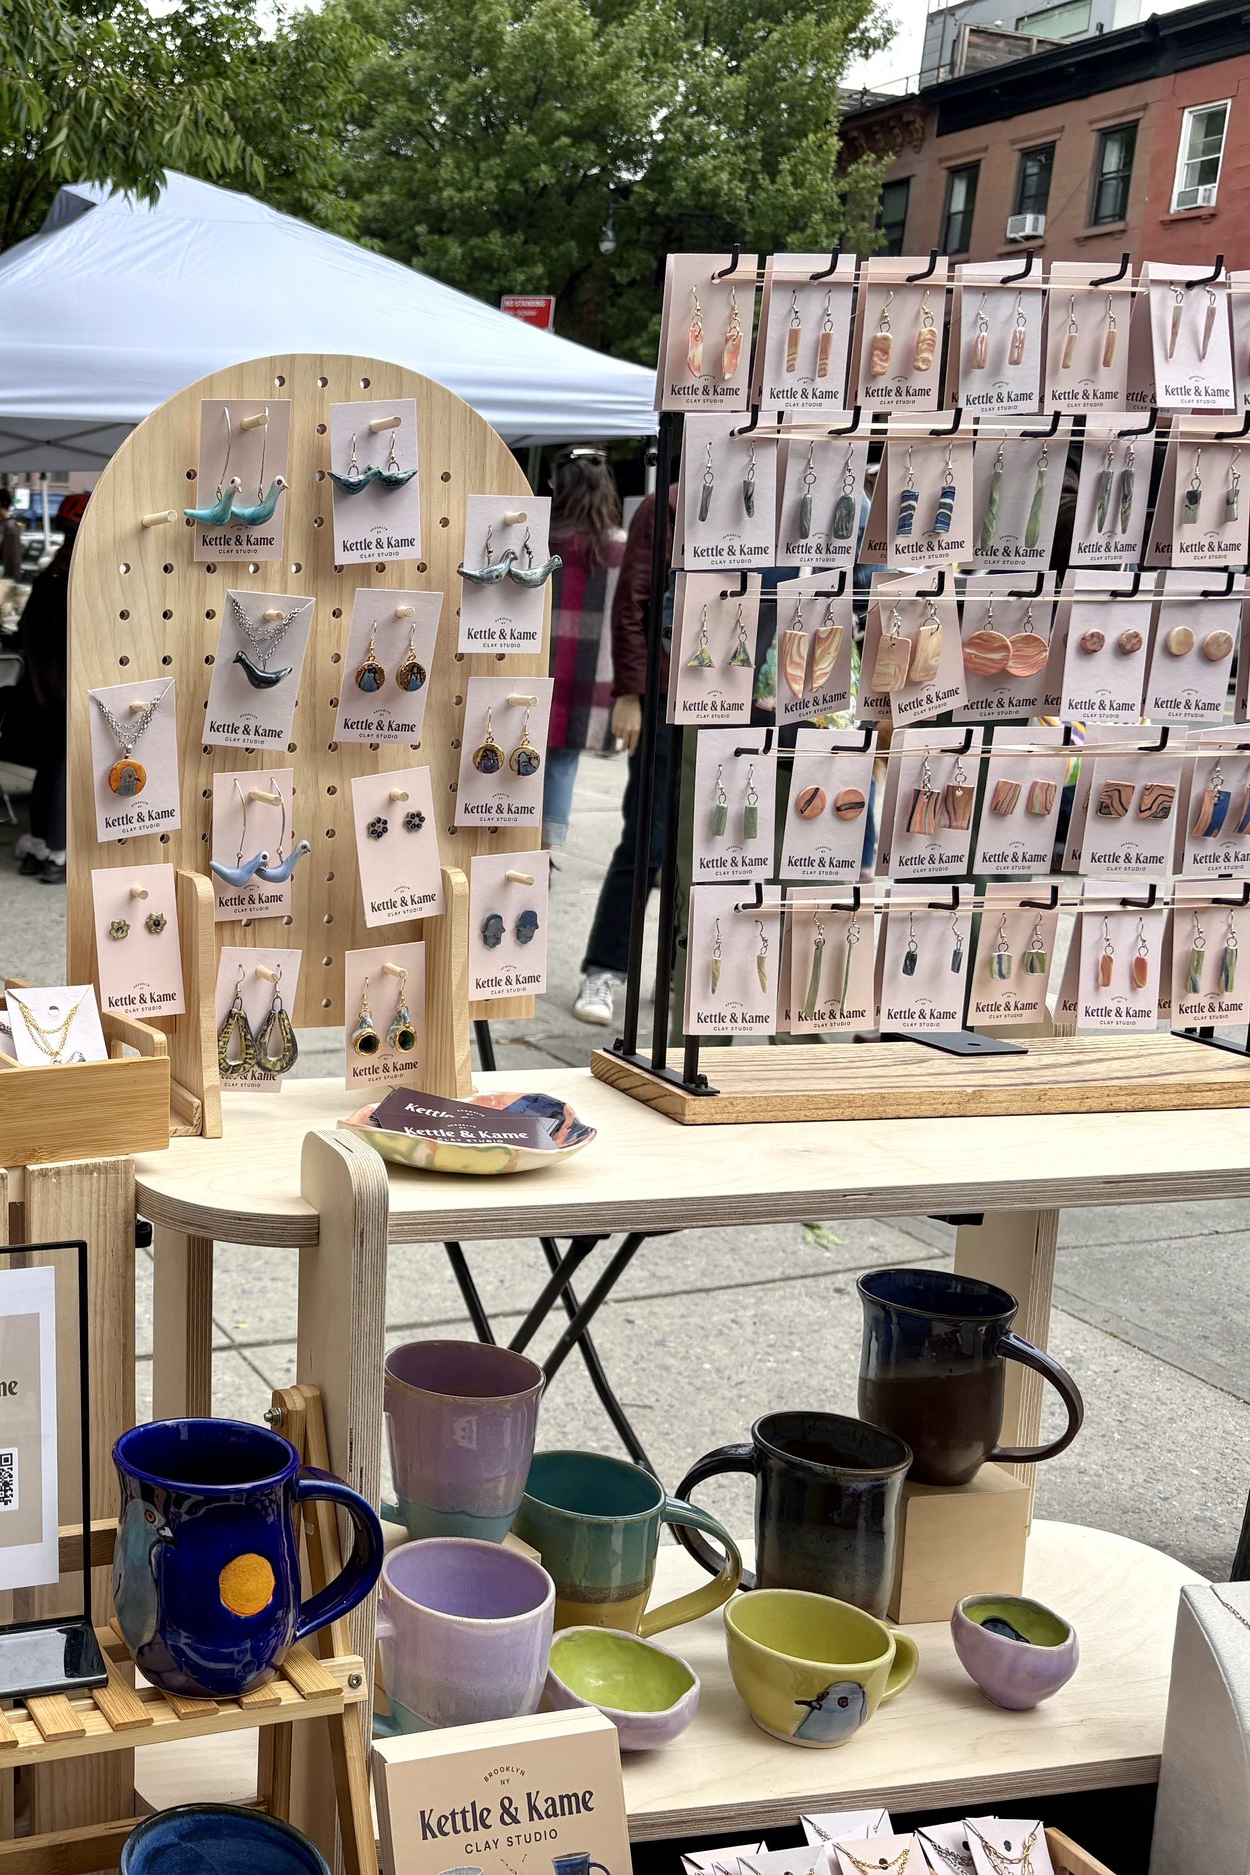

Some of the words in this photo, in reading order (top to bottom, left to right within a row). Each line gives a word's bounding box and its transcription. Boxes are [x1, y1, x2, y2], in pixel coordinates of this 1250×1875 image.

[670, 383, 700, 396] Kettle
[701, 384, 711, 396] &
[712, 383, 741, 396] Kame
[864, 385, 893, 398] Kettle
[894, 385, 903, 398] &
[905, 385, 932, 397] Kame
[1164, 384, 1192, 397] Kettle
[1193, 385, 1203, 397] &
[1204, 385, 1230, 398] Kame
[201, 533, 233, 547] Kettle
[234, 534, 244, 547] &
[245, 534, 275, 547] Kame
[342, 537, 373, 553] Kettle
[375, 537, 385, 550] &
[386, 536, 416, 549] Kame
[895, 541, 925, 555] Kettle
[926, 540, 936, 552] &
[937, 539, 966, 551] Kame
[693, 544, 725, 558] Kettle
[726, 544, 737, 557] &
[739, 544, 770, 556] Kame
[467, 627, 497, 640] Kettle
[498, 628, 507, 640] &
[509, 628, 538, 641] Kame
[682, 700, 709, 712] Kettle
[710, 700, 718, 712] &
[720, 700, 745, 712] Kame
[1067, 698, 1097, 711] Kettle
[1097, 699, 1107, 711] &
[1108, 699, 1136, 712] Kame
[209, 720, 240, 735] Kettle
[241, 723, 252, 736] &
[253, 724, 284, 739] Kame
[343, 717, 374, 731] Kettle
[375, 719, 385, 732] &
[387, 720, 417, 733] Kame
[463, 802, 494, 815] Kettle
[495, 803, 505, 815] &
[506, 803, 536, 815] Kame
[104, 813, 135, 829] Kettle
[136, 811, 146, 823] &
[147, 808, 176, 822] Kame
[699, 856, 728, 869] Kettle
[729, 855, 739, 868] &
[741, 855, 769, 868] Kame
[1090, 851, 1122, 864] Kettle
[1123, 852, 1133, 864] &
[1134, 852, 1165, 865] Kame
[218, 894, 246, 908] Kettle
[247, 893, 256, 906] &
[258, 893, 284, 905] Kame
[370, 898, 398, 913] Kettle
[400, 895, 409, 908] &
[409, 893, 437, 906] Kame
[475, 976, 503, 990] Kettle
[504, 975, 513, 987] &
[515, 973, 542, 986] Kame
[108, 994, 137, 1008] Kettle
[138, 993, 148, 1005] &
[149, 992, 177, 1004] Kame
[975, 1001, 1002, 1013] Kettle
[1003, 1000, 1012, 1012] &
[1013, 1000, 1039, 1012] Kame
[696, 1012, 727, 1024] Kettle
[729, 1012, 739, 1024] &
[741, 1012, 770, 1024] Kame
[887, 1008, 917, 1020] Kettle
[917, 1008, 927, 1020] &
[929, 1008, 958, 1020] Kame
[352, 1064, 380, 1078] Kettle
[381, 1062, 391, 1074] &
[392, 1060, 419, 1073] Kame
[403, 1126, 455, 1138] Kettle
[459, 1130, 477, 1139] &
[478, 1130, 530, 1140] Kame
[483, 1765, 526, 1783] BROOKLYN
[500, 1778, 510, 1786] NY
[419, 1799, 493, 1841] Kettle
[499, 1795, 522, 1827] &
[525, 1789, 595, 1823] Kame
[464, 1838, 500, 1855] CLAY
[506, 1828, 558, 1847] STUDIO
